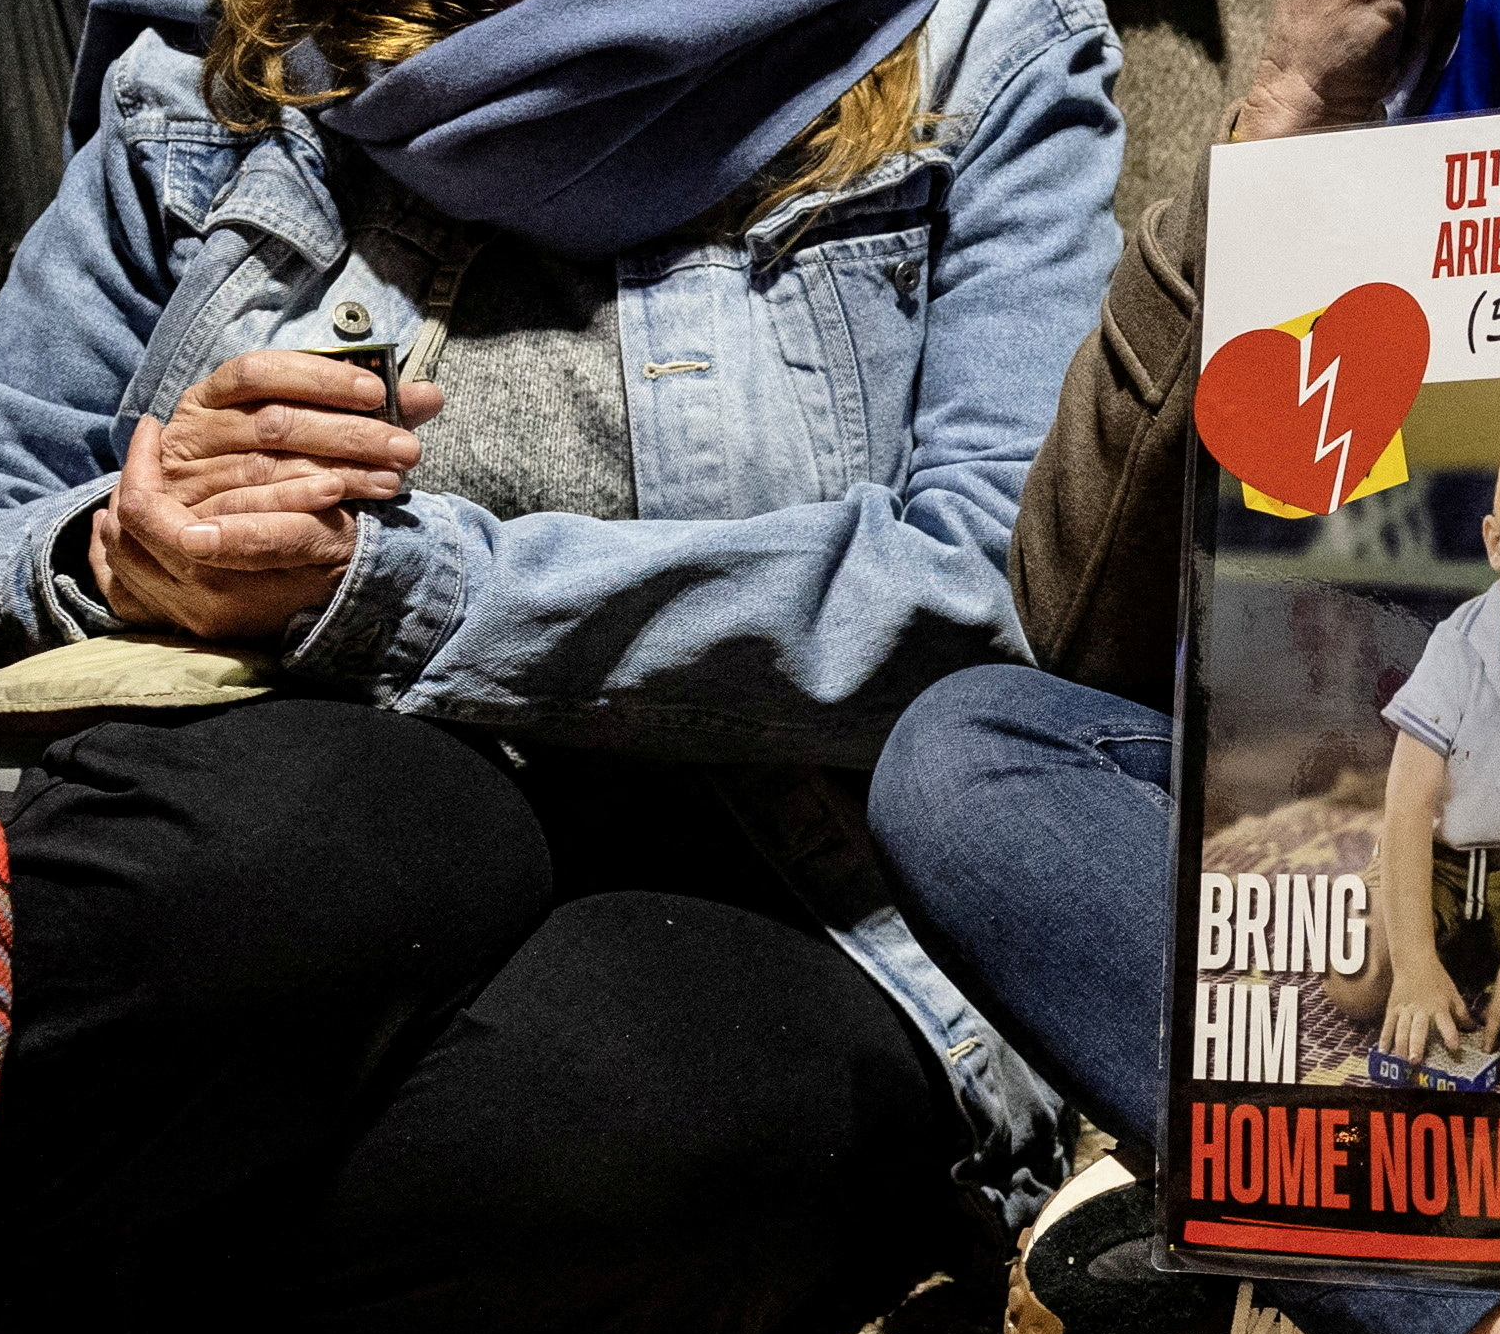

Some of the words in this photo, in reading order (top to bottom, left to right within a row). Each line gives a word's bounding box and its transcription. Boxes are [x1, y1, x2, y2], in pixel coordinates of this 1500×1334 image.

[1198, 871, 1369, 976] BRING
[1192, 981, 1300, 1086] HIM
[1190, 1101, 1351, 1211] HOME
